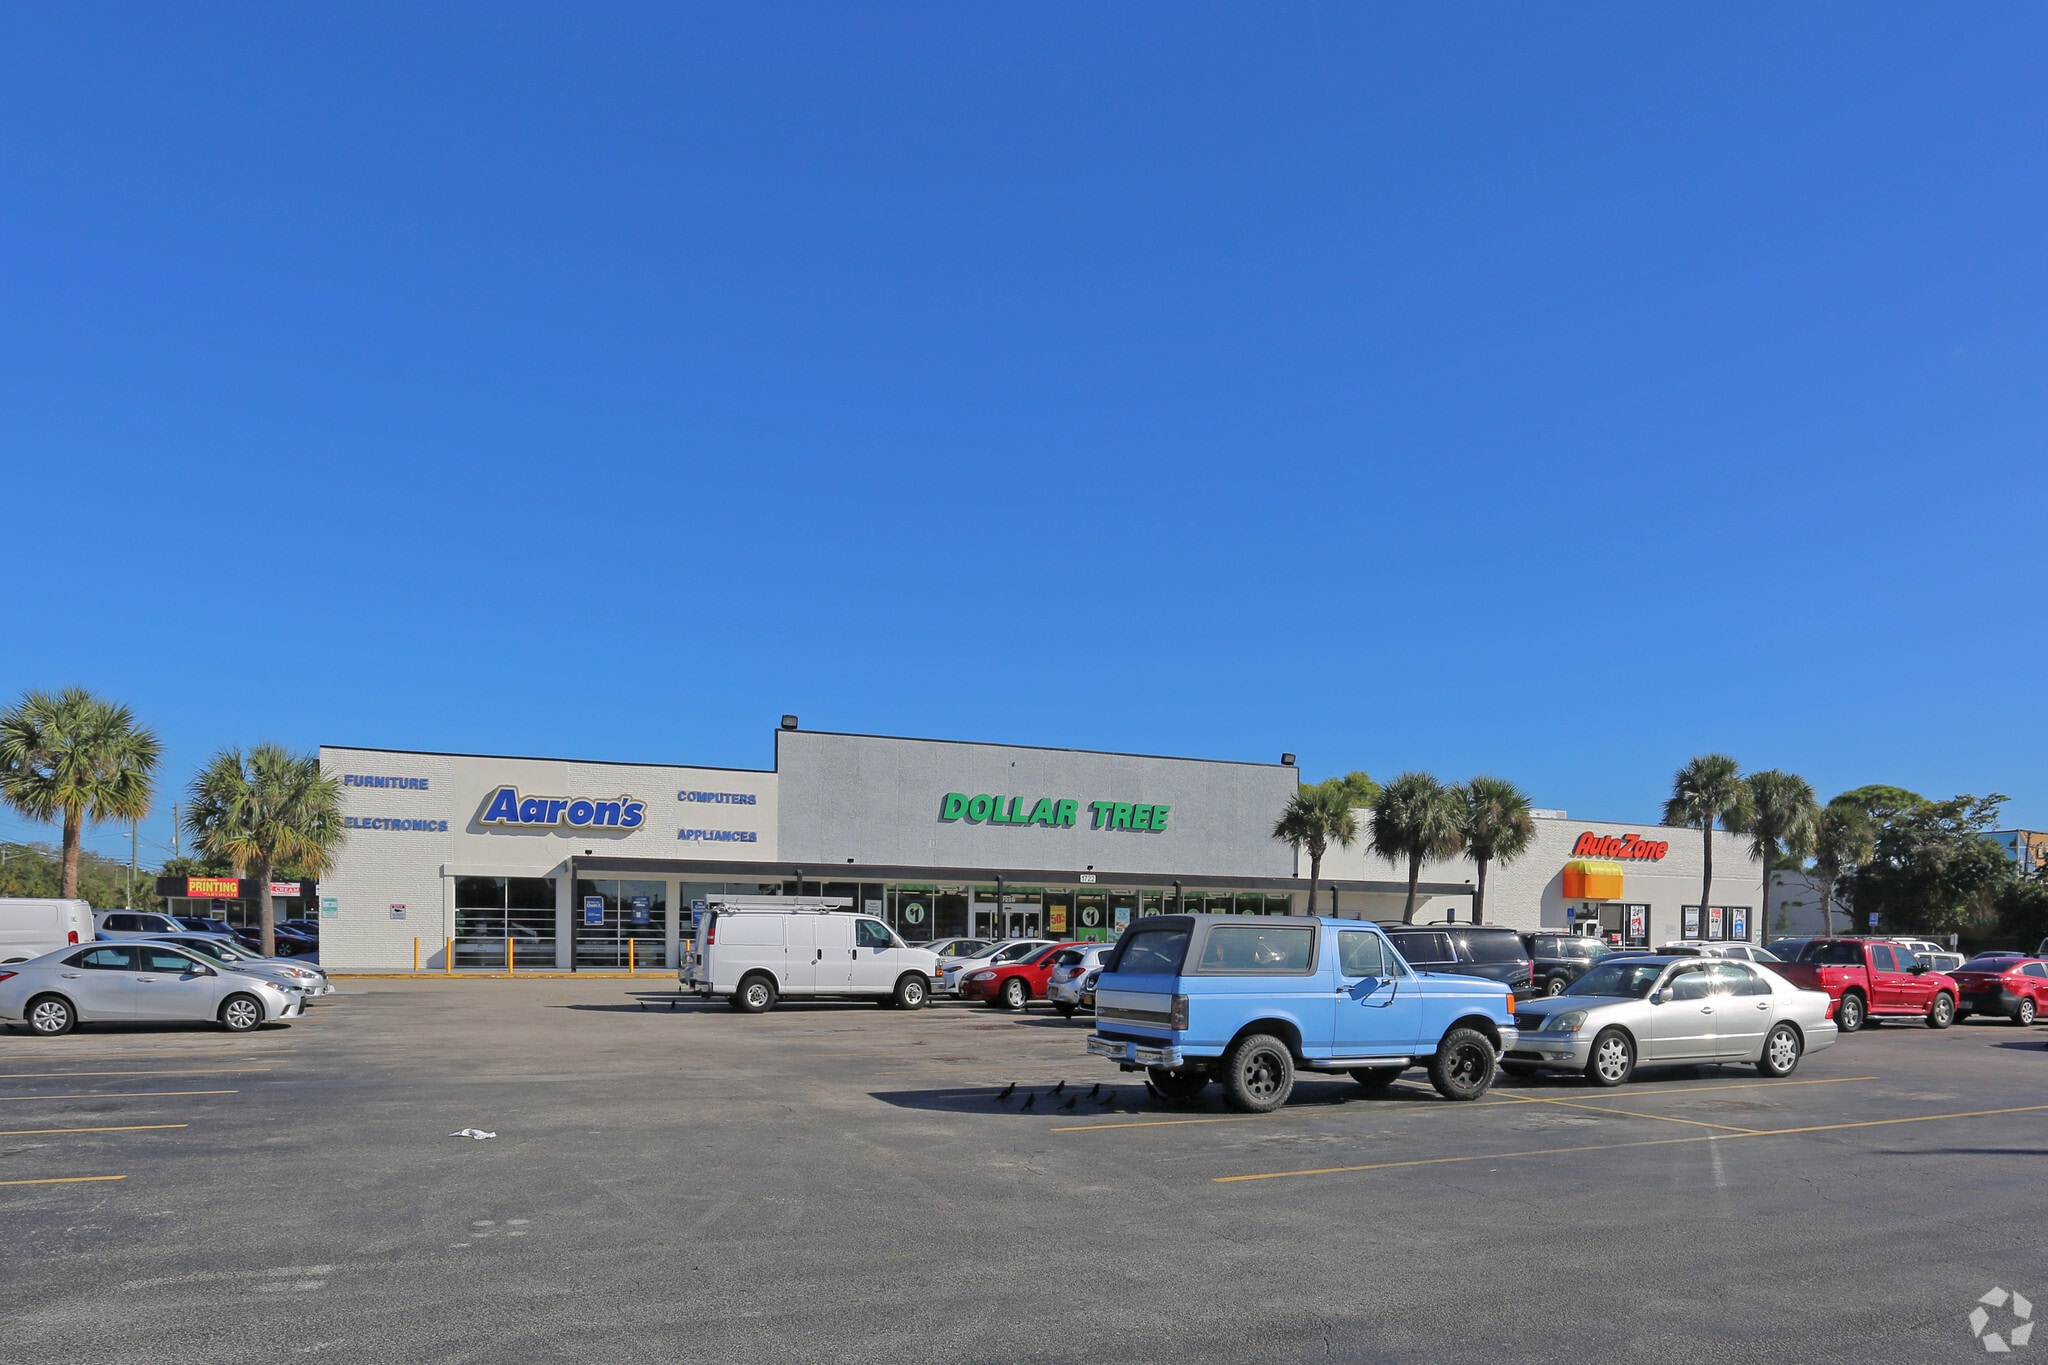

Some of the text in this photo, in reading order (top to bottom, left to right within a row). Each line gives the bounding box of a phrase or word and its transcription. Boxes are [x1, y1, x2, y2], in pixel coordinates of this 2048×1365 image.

[344, 774, 429, 790] FURNITURE
[677, 790, 757, 805] COMPUTERS
[481, 788, 645, 827] Aaron's
[943, 792, 1171, 830] DOLLAR TREE
[345, 816, 448, 832] ELECTRONICS
[677, 828, 758, 843] APPLIANCES
[1573, 831, 1669, 860] AutoZone
[189, 881, 238, 893] PRINTING
[1081, 875, 1095, 883] 1722
